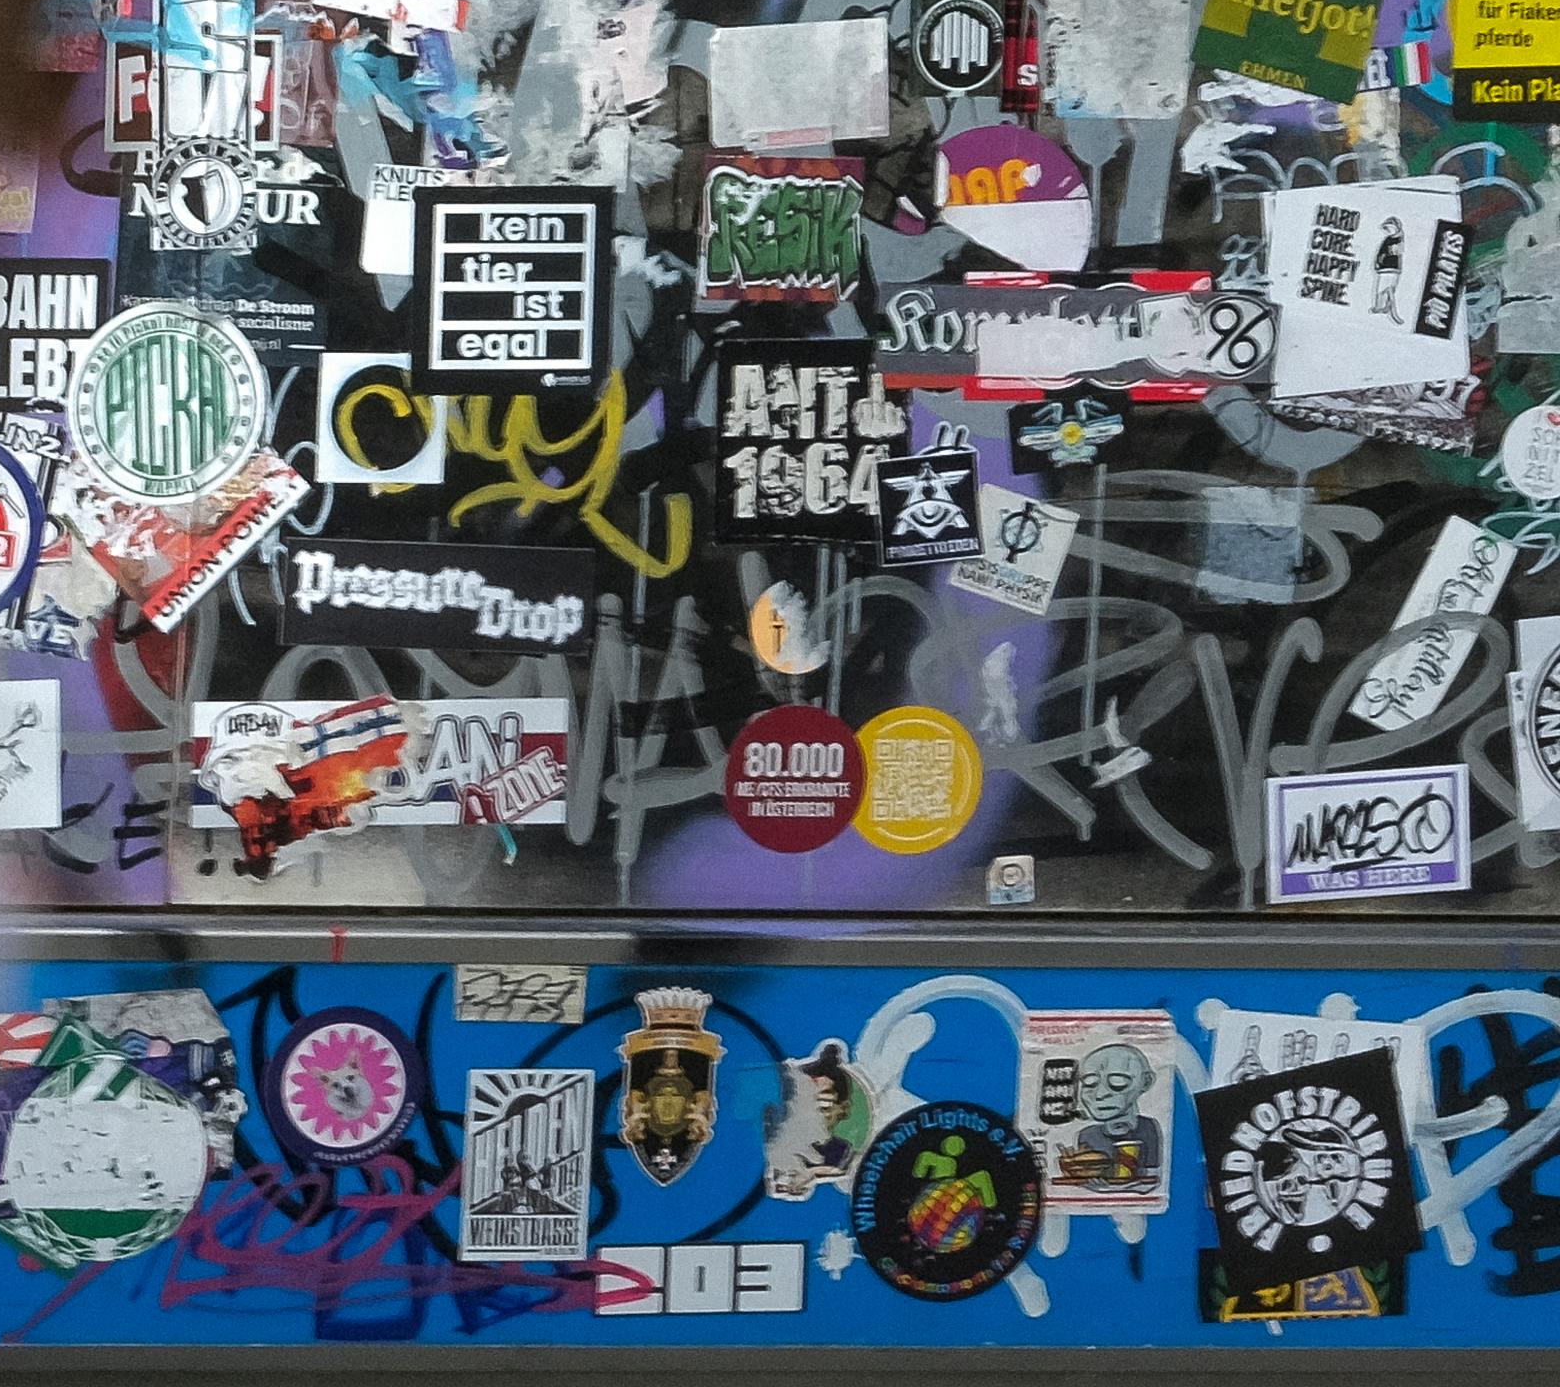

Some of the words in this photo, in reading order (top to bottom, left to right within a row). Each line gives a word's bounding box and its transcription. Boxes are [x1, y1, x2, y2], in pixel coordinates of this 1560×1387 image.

[1474, 27, 1535, 51] pferde
[1471, 78, 1526, 103] Kein
[479, 210, 566, 242] kein
[461, 255, 534, 285] tier
[513, 291, 565, 321] ist
[456, 333, 548, 363] egal
[723, 444, 881, 520] 1964
[475, 587, 584, 639] Drop
[742, 742, 846, 779] 80.000
